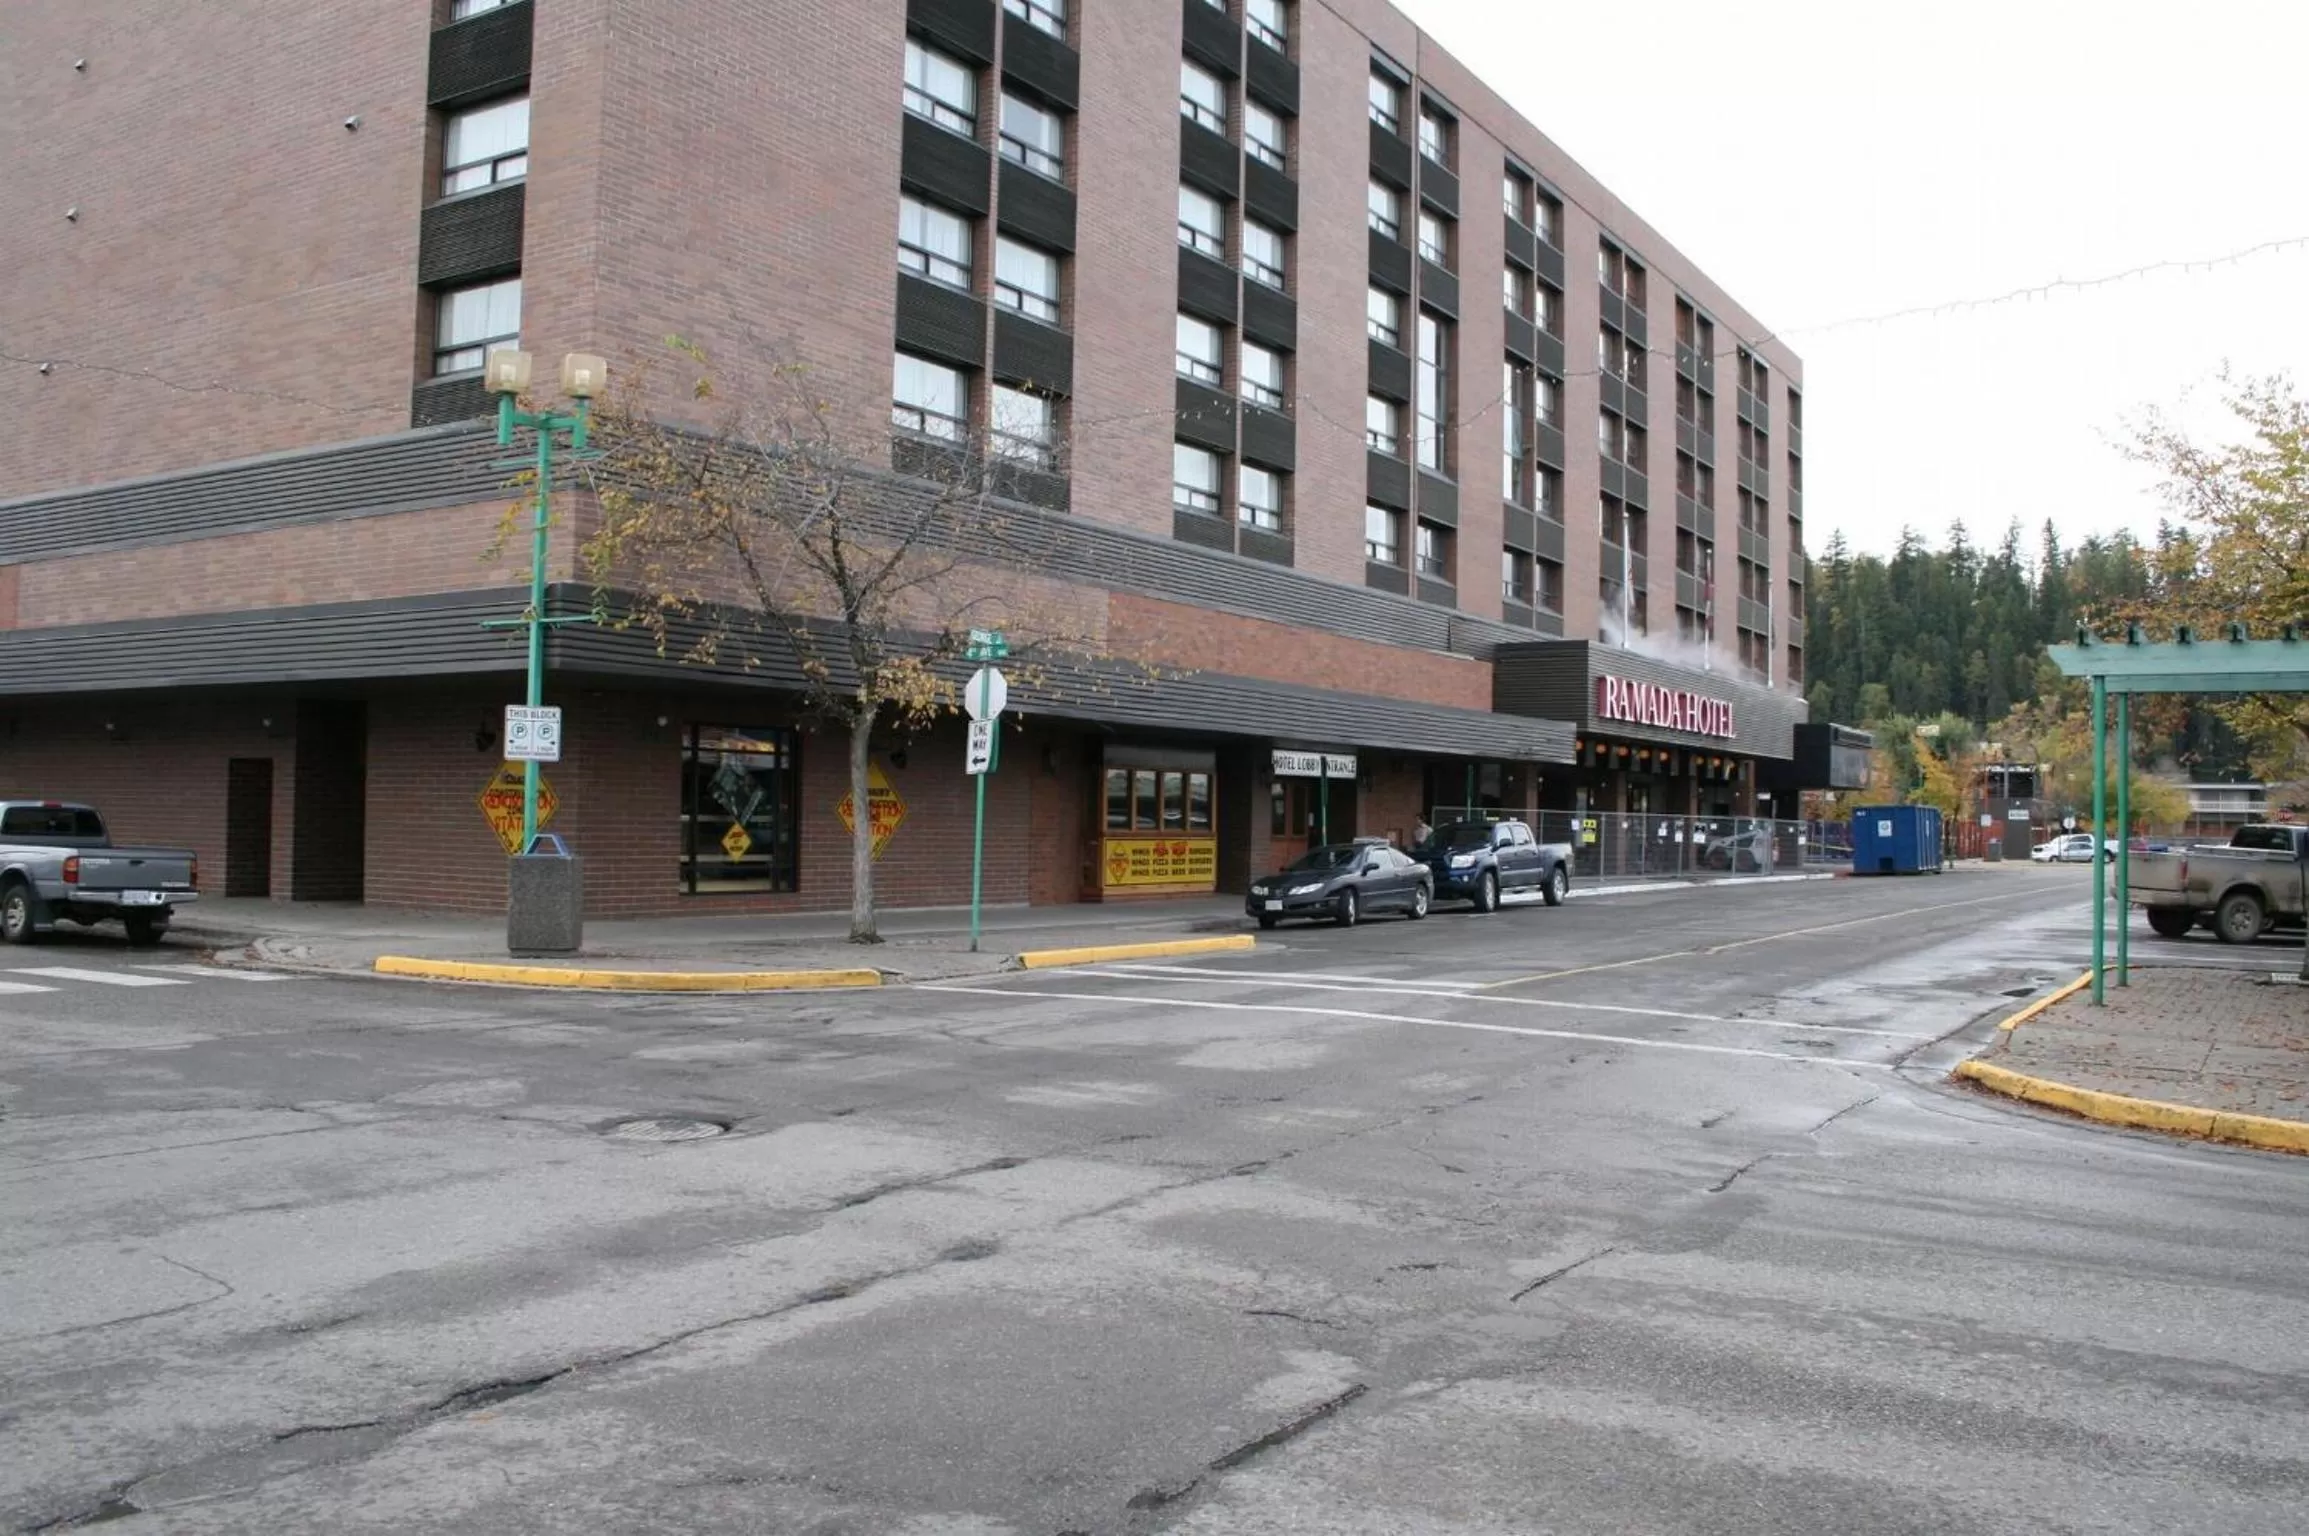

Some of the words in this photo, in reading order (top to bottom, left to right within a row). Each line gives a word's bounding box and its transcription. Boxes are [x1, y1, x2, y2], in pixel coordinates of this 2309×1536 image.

[1604, 675, 1683, 731] RAMADA
[1685, 691, 1736, 739] HOTEL
[972, 723, 988, 737] ONE
[972, 738, 987, 751] WAY
[1326, 758, 1356, 774] NTRANCE
